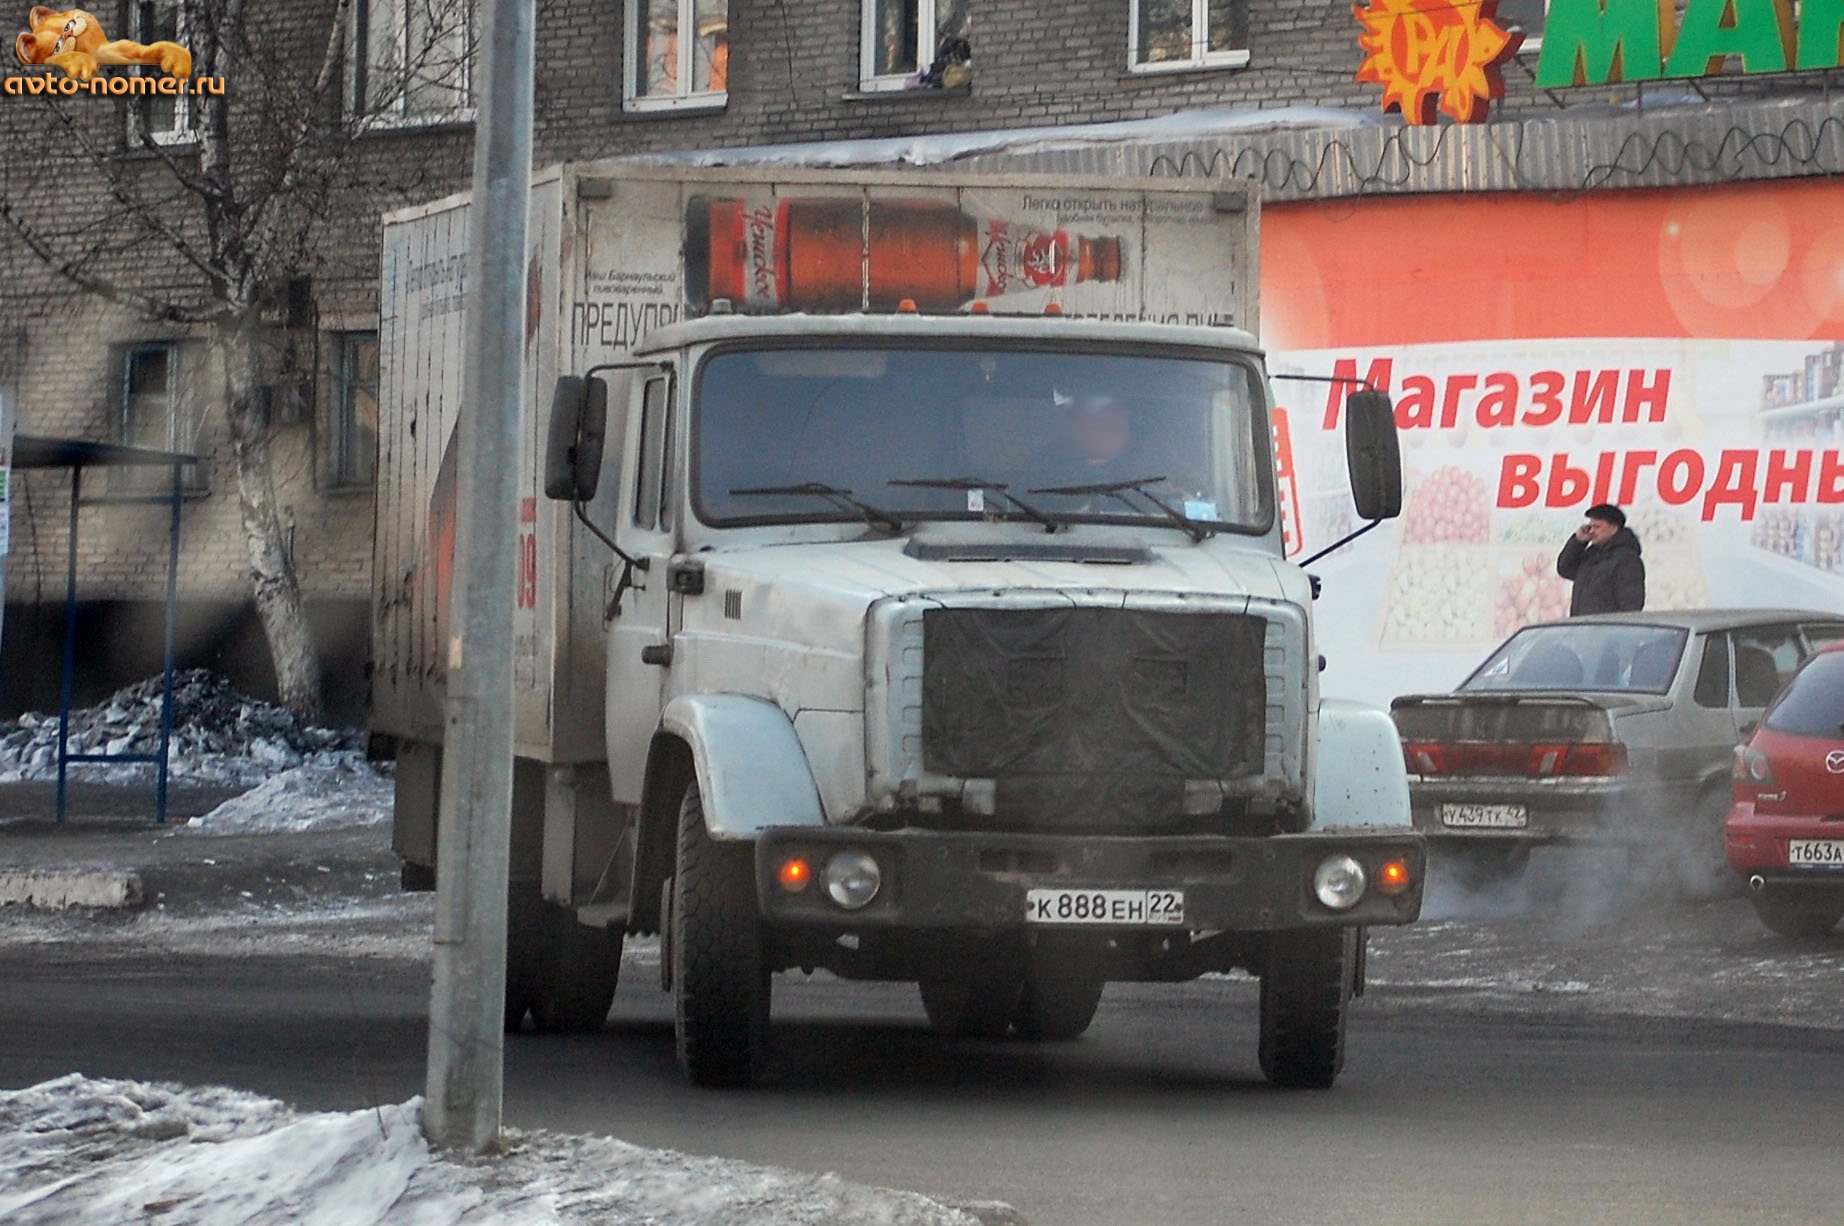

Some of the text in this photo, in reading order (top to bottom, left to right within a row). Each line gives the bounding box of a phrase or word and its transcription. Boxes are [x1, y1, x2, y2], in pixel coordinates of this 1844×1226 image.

[1063, 199, 1117, 213] открыть
[608, 269, 677, 284] Барнаульский
[1322, 357, 1672, 431] Магазин
[1150, 894, 1175, 913] 22
